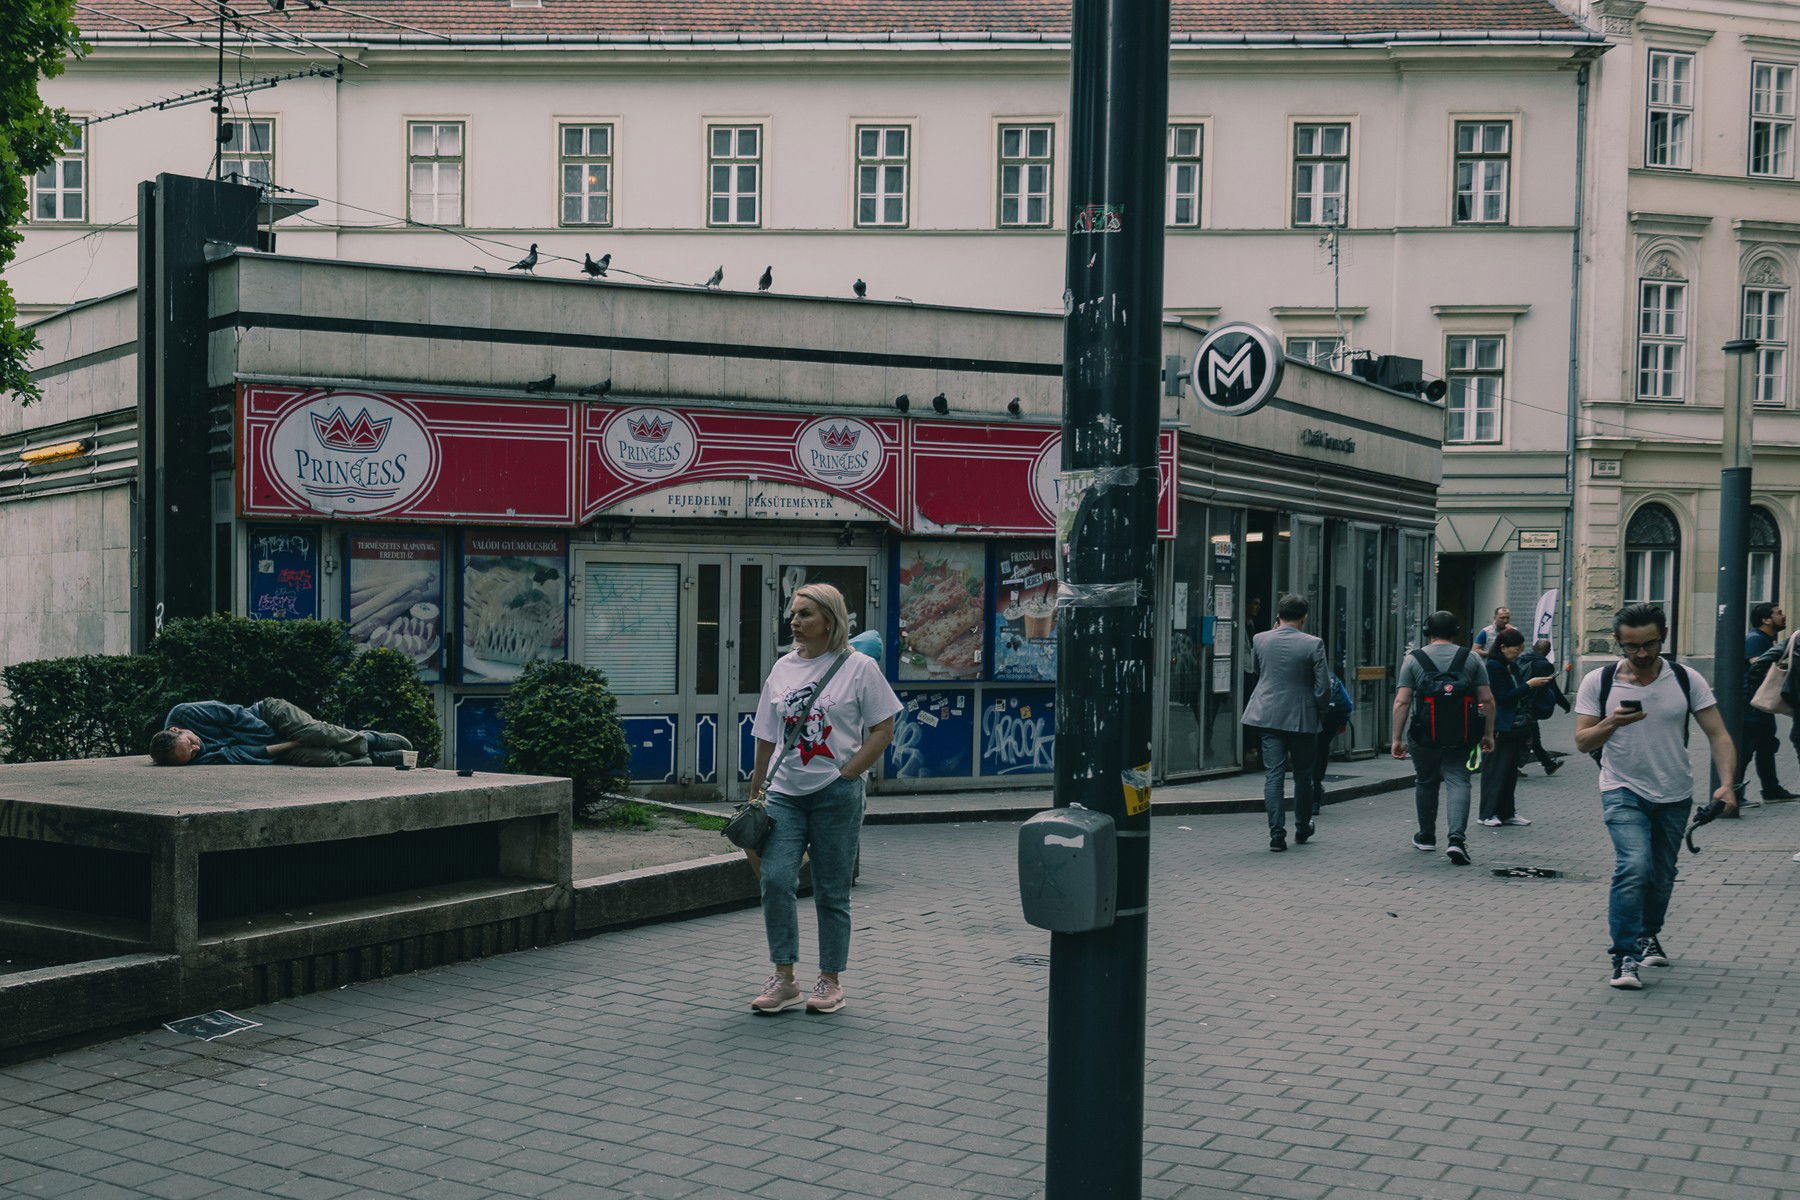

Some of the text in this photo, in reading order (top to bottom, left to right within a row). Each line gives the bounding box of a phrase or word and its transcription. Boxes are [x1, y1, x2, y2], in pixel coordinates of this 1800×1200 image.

[618, 440, 681, 463] PRINCESS
[810, 449, 869, 471] PRINCESS
[294, 449, 408, 488] PRINCESS
[668, 494, 732, 507] FEJEDELMI
[357, 541, 401, 550] TERMÉSZETES
[379, 551, 406, 559] EREDETI
